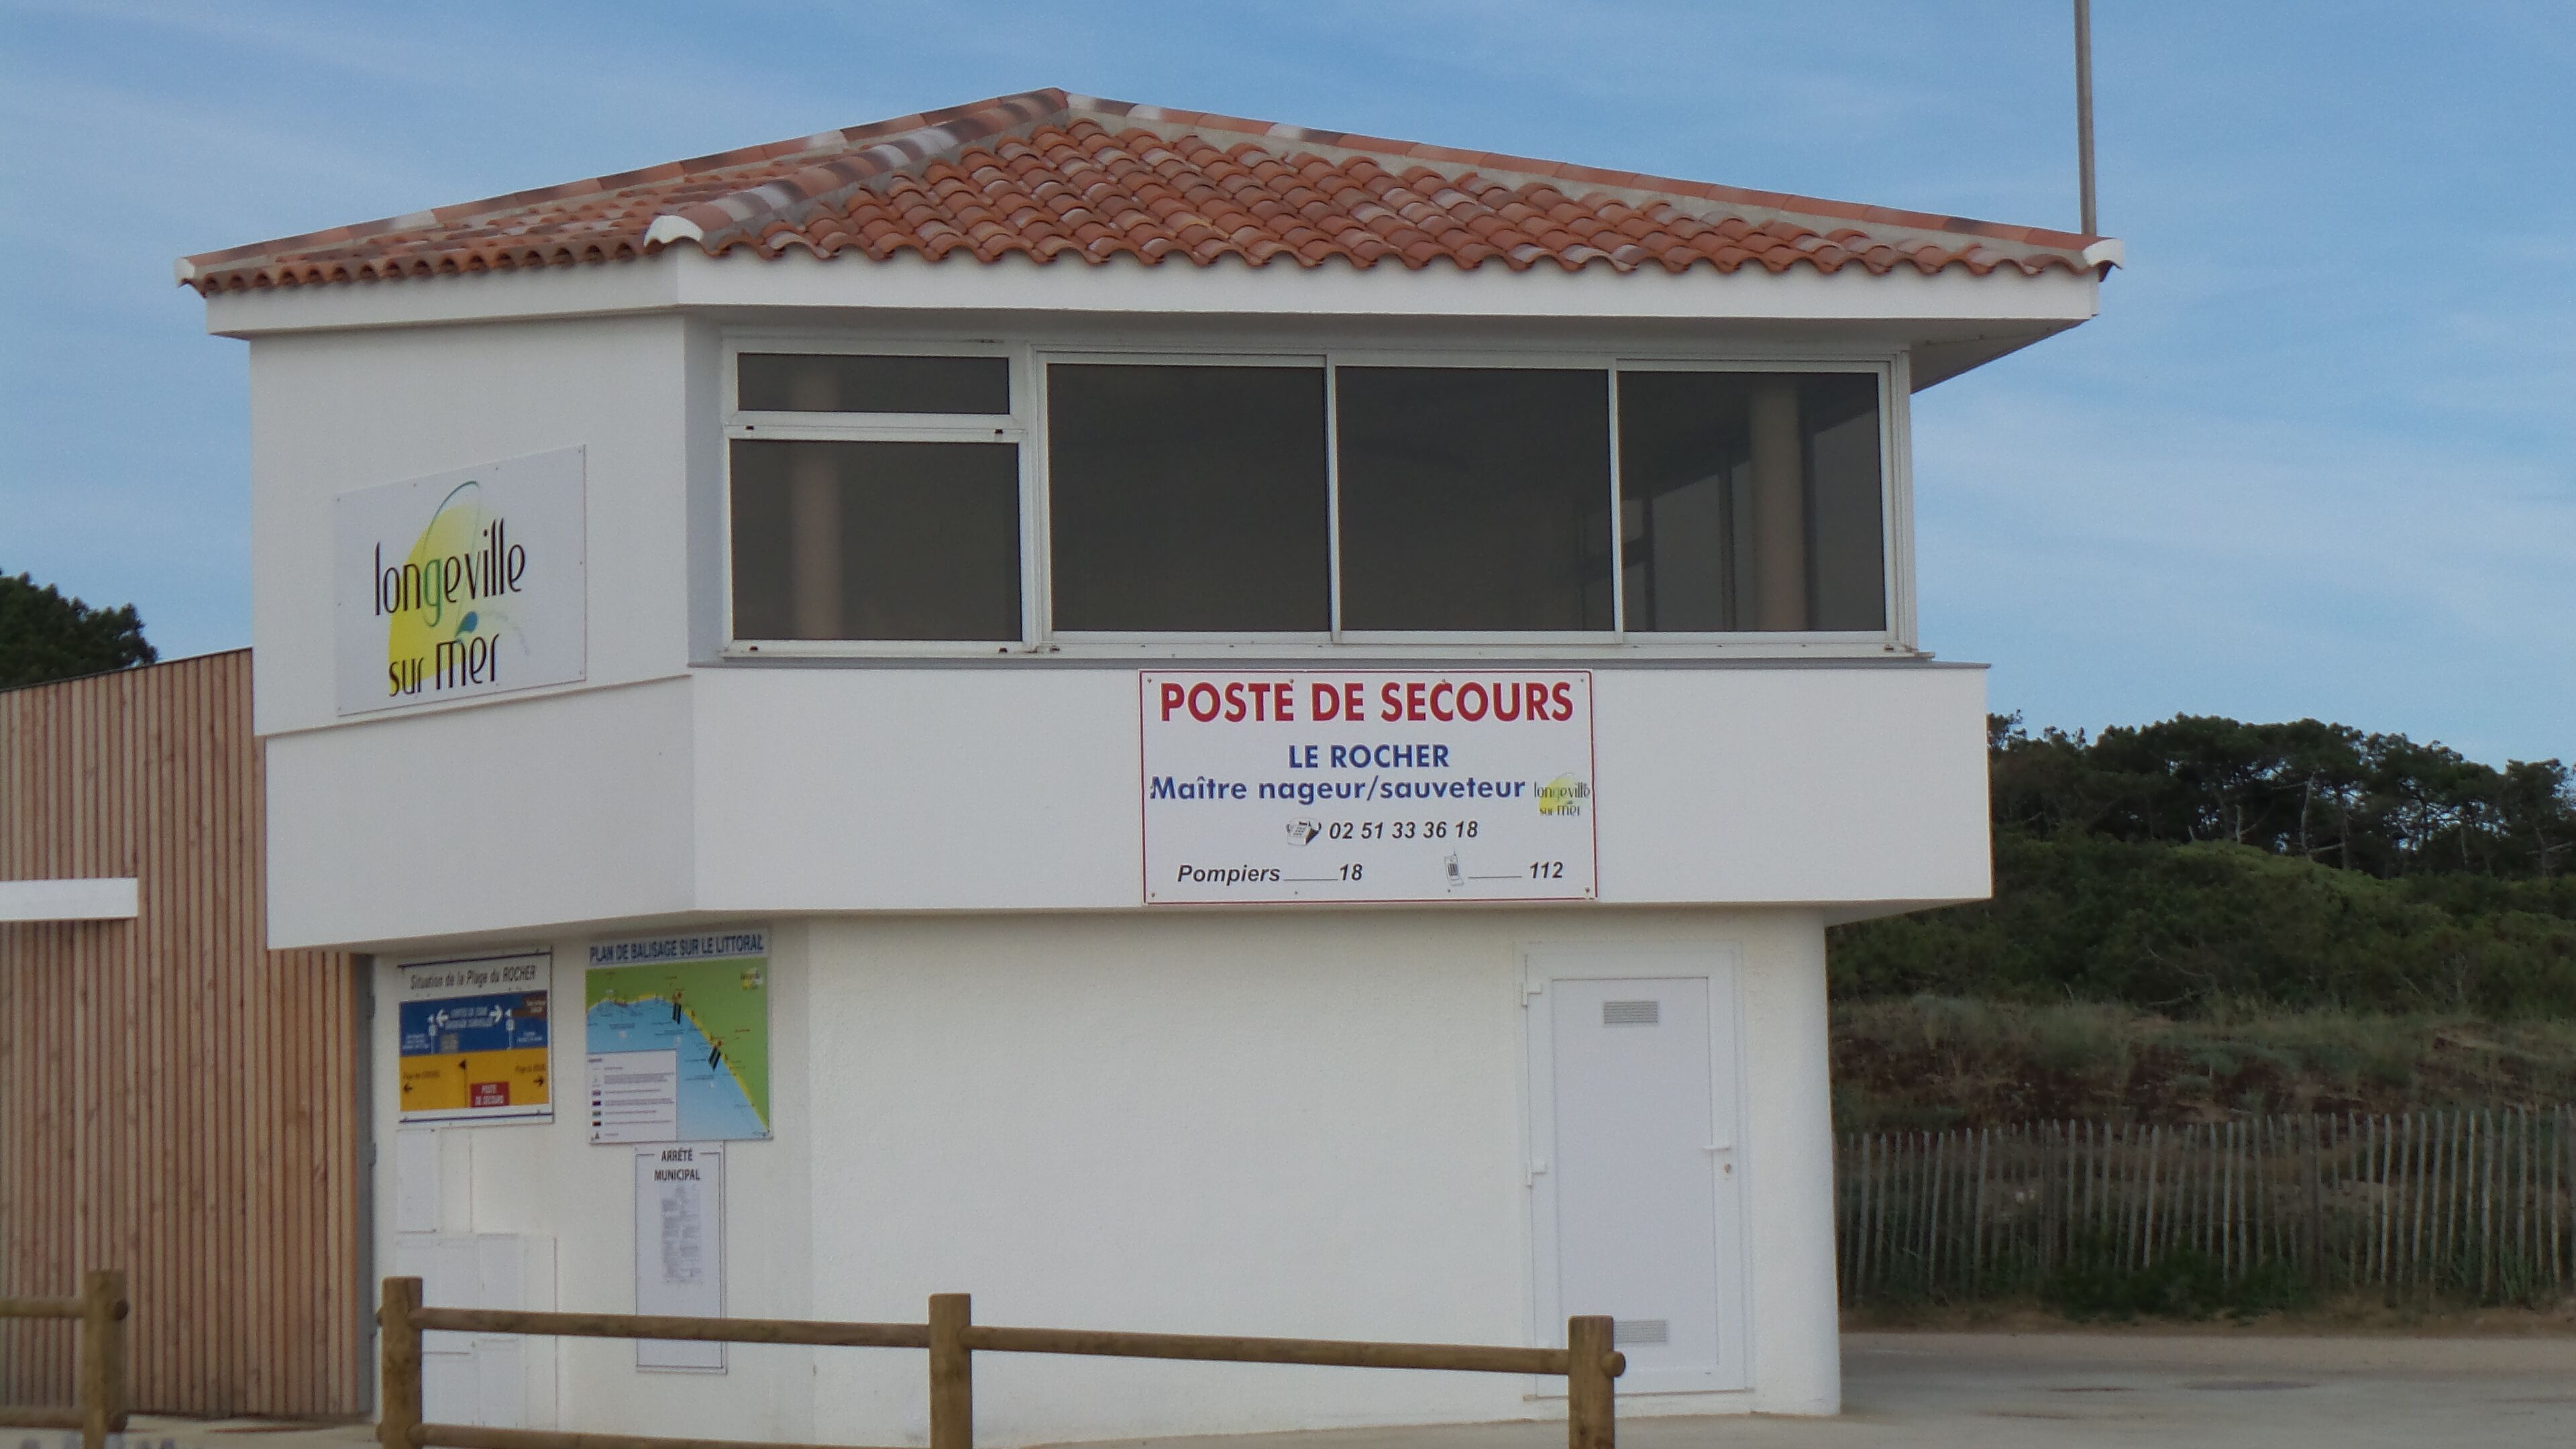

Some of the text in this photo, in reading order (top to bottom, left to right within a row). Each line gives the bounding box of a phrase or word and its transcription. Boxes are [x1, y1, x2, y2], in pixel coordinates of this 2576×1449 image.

[374, 518, 525, 627] longeville
[388, 633, 500, 698] sur mer
[1161, 681, 1574, 722] POSTE DE SECOURS
[1289, 745, 1449, 769] LE ROCHER
[1151, 775, 1525, 805] Maître nageur/sauveteur
[1534, 781, 1591, 802] longeville
[1329, 821, 1478, 839] 02 51 33 36 18
[1177, 864, 1363, 885] Pompiers 18
[1529, 862, 1564, 879] 112
[590, 945, 613, 962] PLAN
[616, 945, 629, 960] DE
[680, 939, 699, 956] SUR
[702, 937, 714, 954] LE
[716, 934, 764, 953] LITTORAL
[503, 965, 536, 982] ROCHER
[654, 1169, 700, 1181] MUNICIPAL
